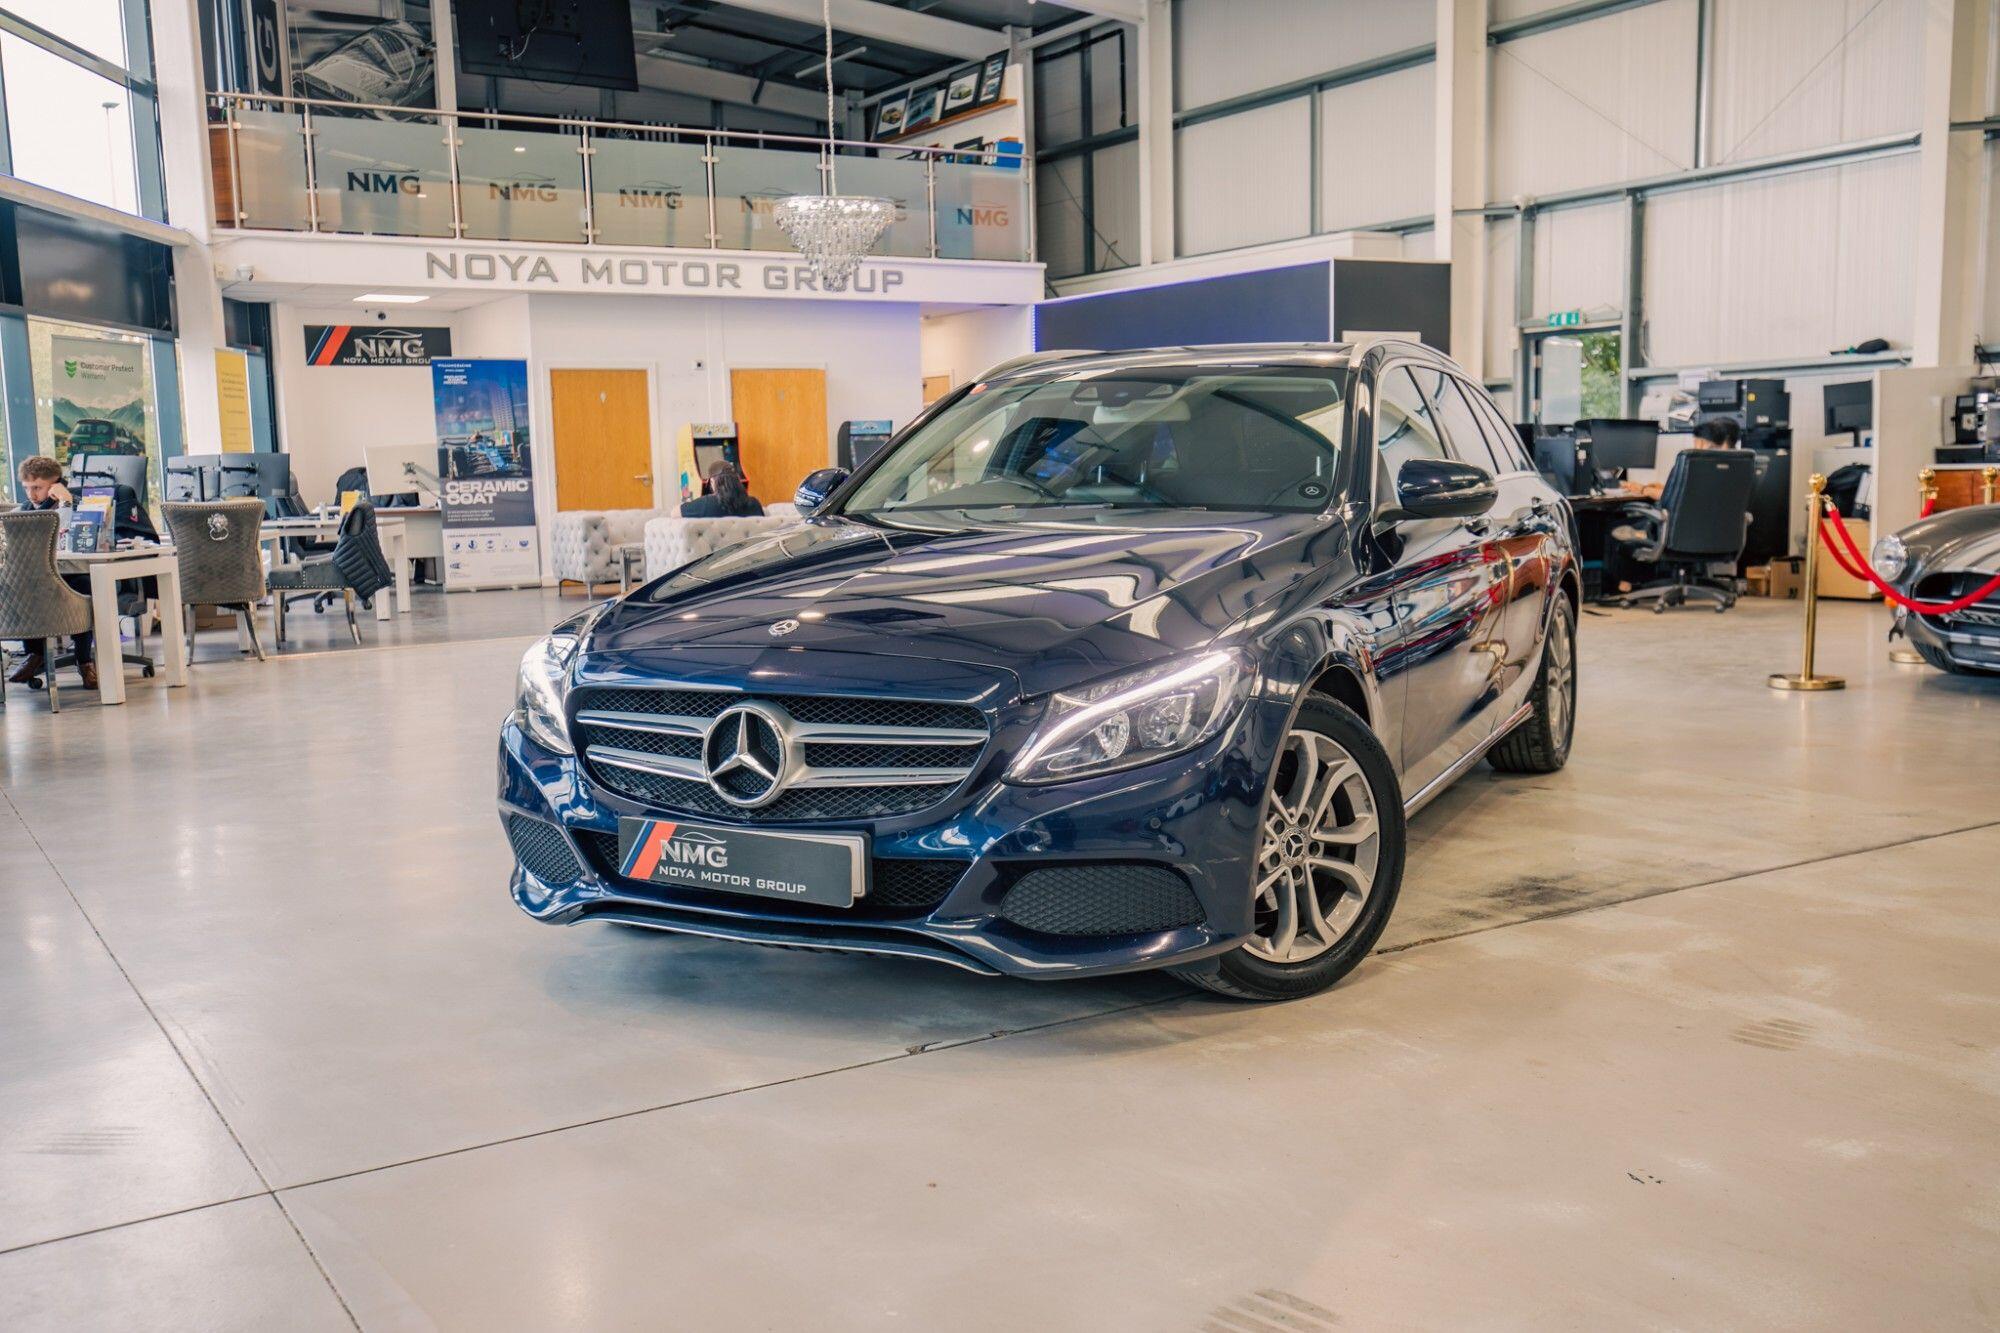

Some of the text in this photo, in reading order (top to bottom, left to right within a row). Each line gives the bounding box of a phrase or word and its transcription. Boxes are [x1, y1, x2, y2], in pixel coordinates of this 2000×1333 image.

[347, 171, 421, 195] NMG
[489, 182, 558, 203] NMG
[619, 189, 684, 210] NMG
[956, 208, 1009, 227] NMG
[426, 251, 559, 283] NOYA
[581, 257, 741, 289] MOTOR
[353, 338, 425, 358] NMG
[80, 361, 111, 371] Customer
[342, 356, 432, 365] NOYA MOTOR GROU
[445, 480, 529, 493] CERAMIC
[446, 492, 498, 505] COAT
[660, 840, 728, 868] NMG
[659, 866, 807, 895] NOYA MOTOR GROUP
